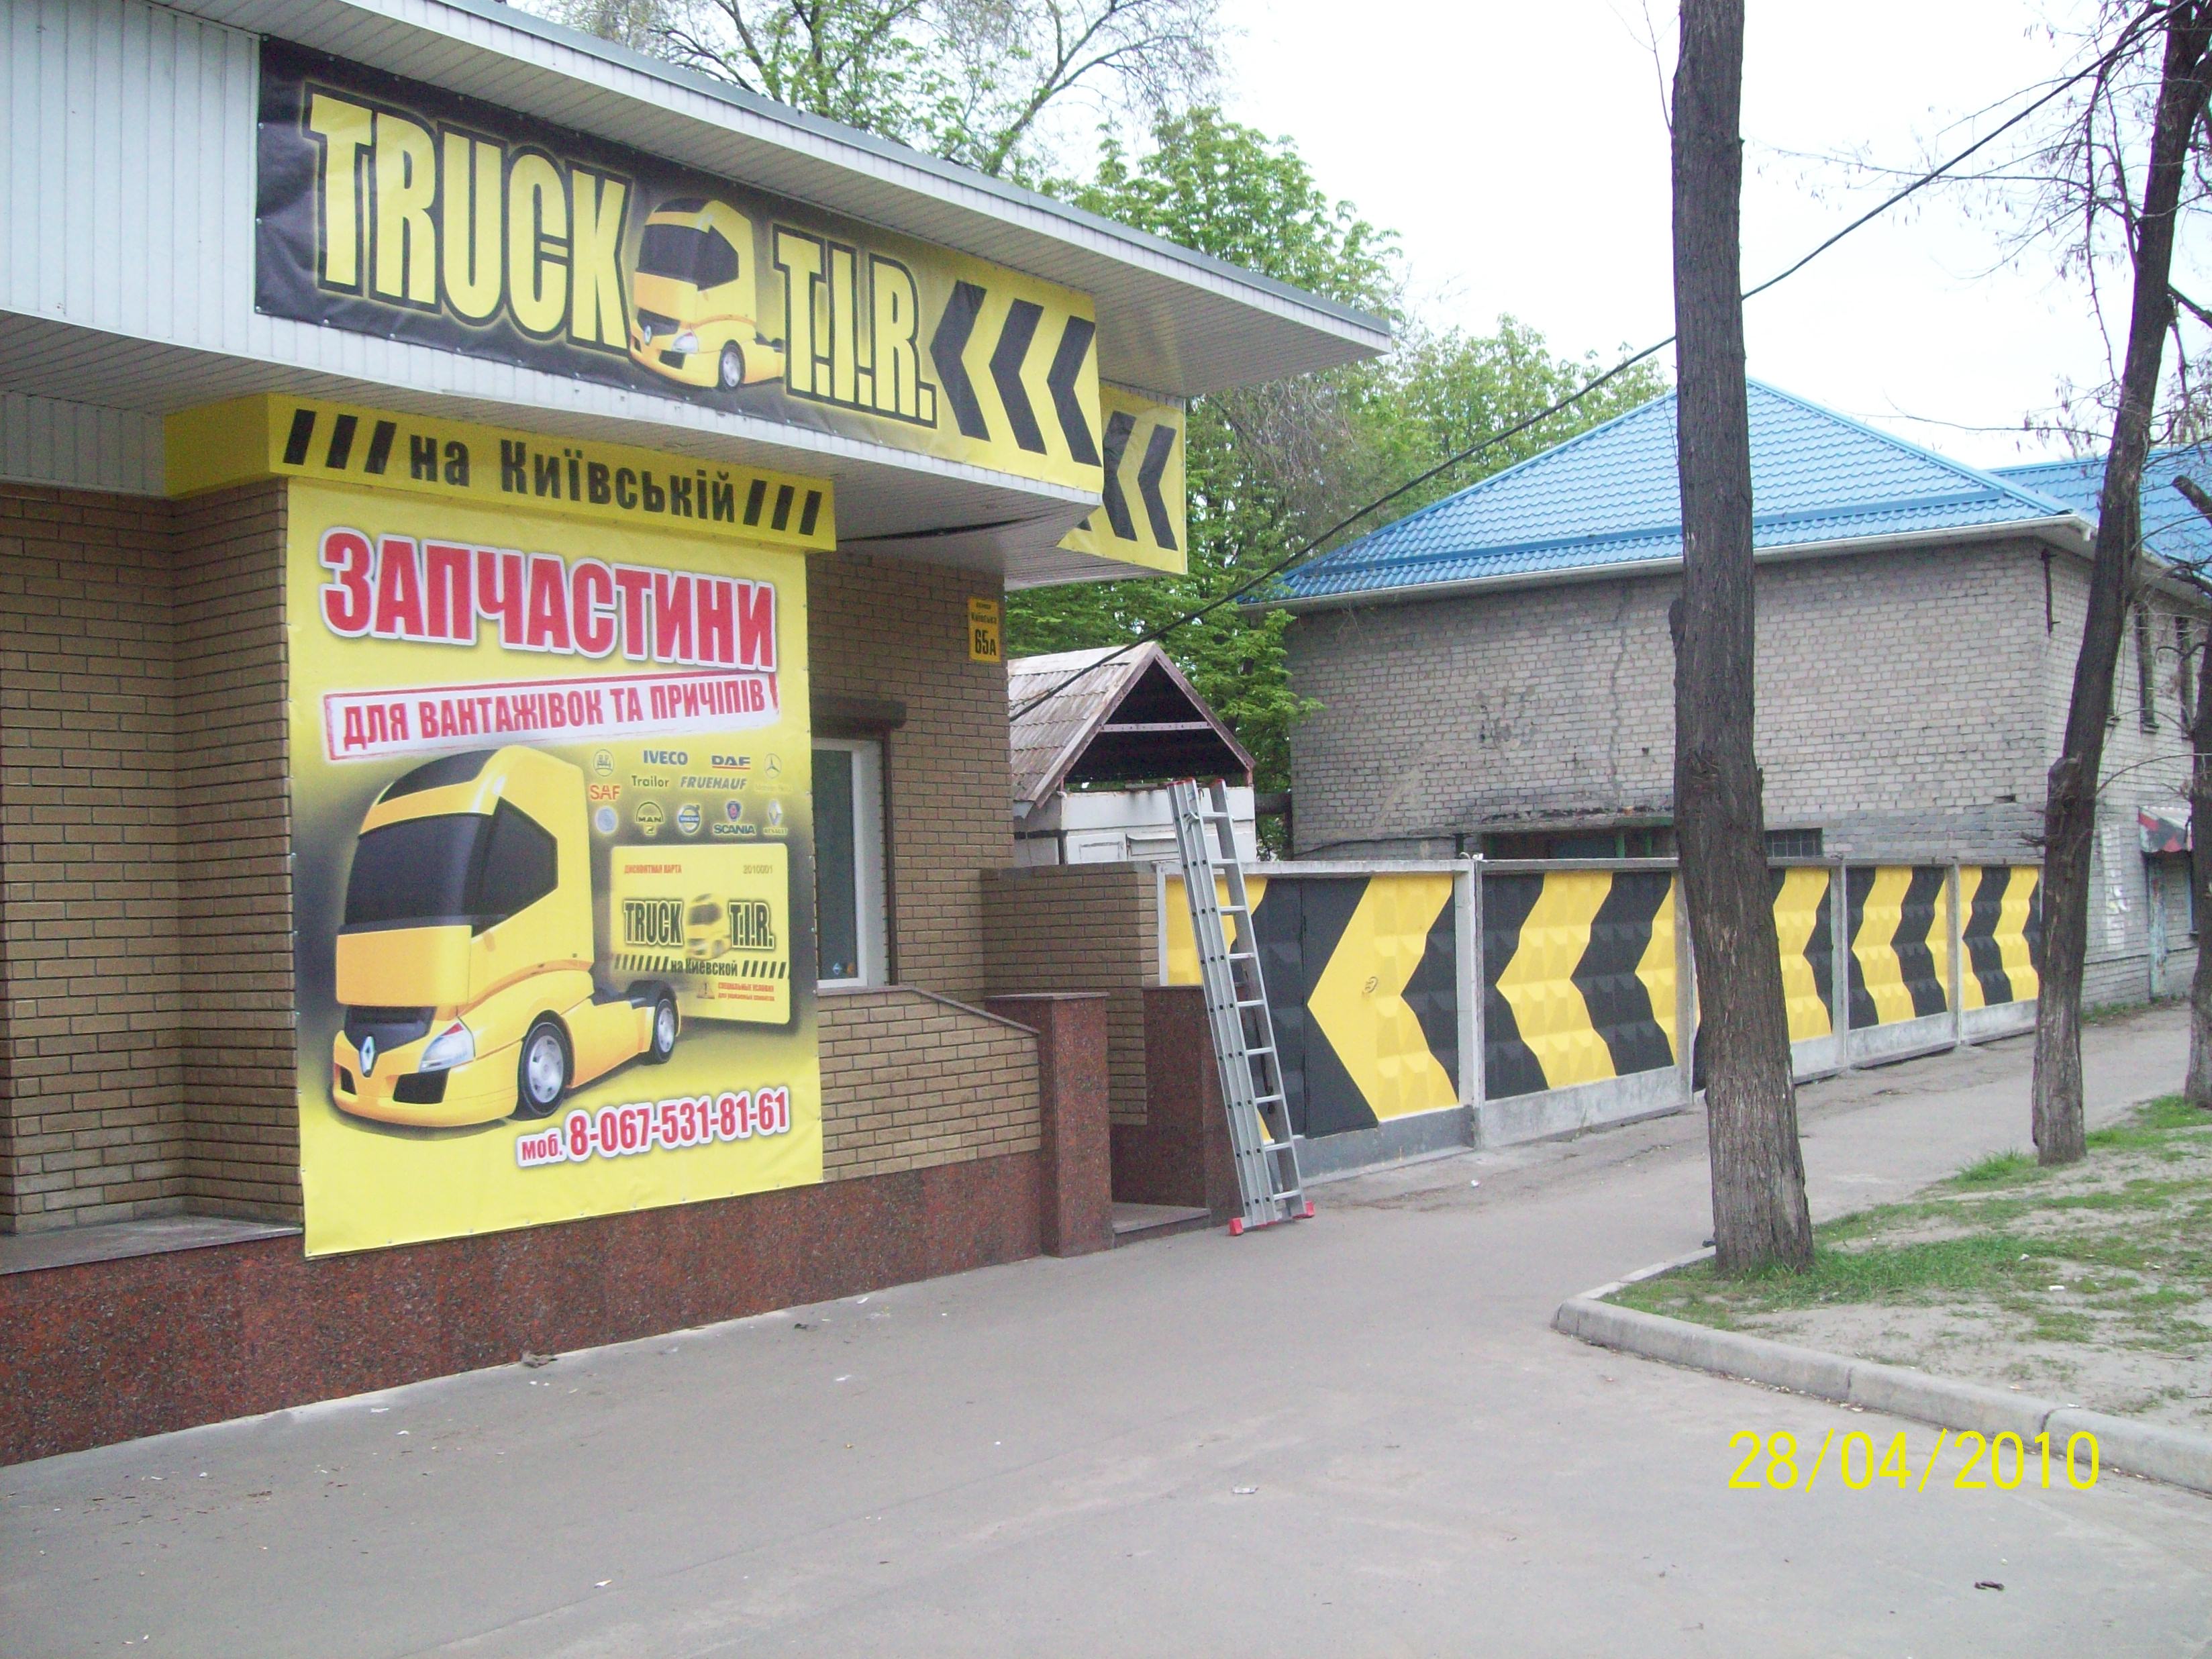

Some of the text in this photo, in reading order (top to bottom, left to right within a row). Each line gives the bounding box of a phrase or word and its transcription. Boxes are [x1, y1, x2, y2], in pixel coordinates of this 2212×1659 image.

[307, 91, 934, 424] TRUCK T.I.R.
[410, 434, 736, 523] на Київській
[323, 531, 774, 670] ЗАПЧАСТИНИ
[344, 678, 766, 751] ДЛЯ ВАНТАЖІВОК ТА ПРИЧІПІВ
[643, 750, 689, 766] IVECO
[711, 755, 751, 766] DAF
[631, 775, 669, 788] Trailor
[680, 776, 748, 791] FRUEHAUF
[590, 785, 621, 800] SAF
[713, 824, 756, 835] SCANIA
[624, 901, 775, 949] TRUCK T.I.R.
[671, 958, 738, 977] на Киевской
[521, 1091, 789, 1161] моб. 8-067-531-81-61
